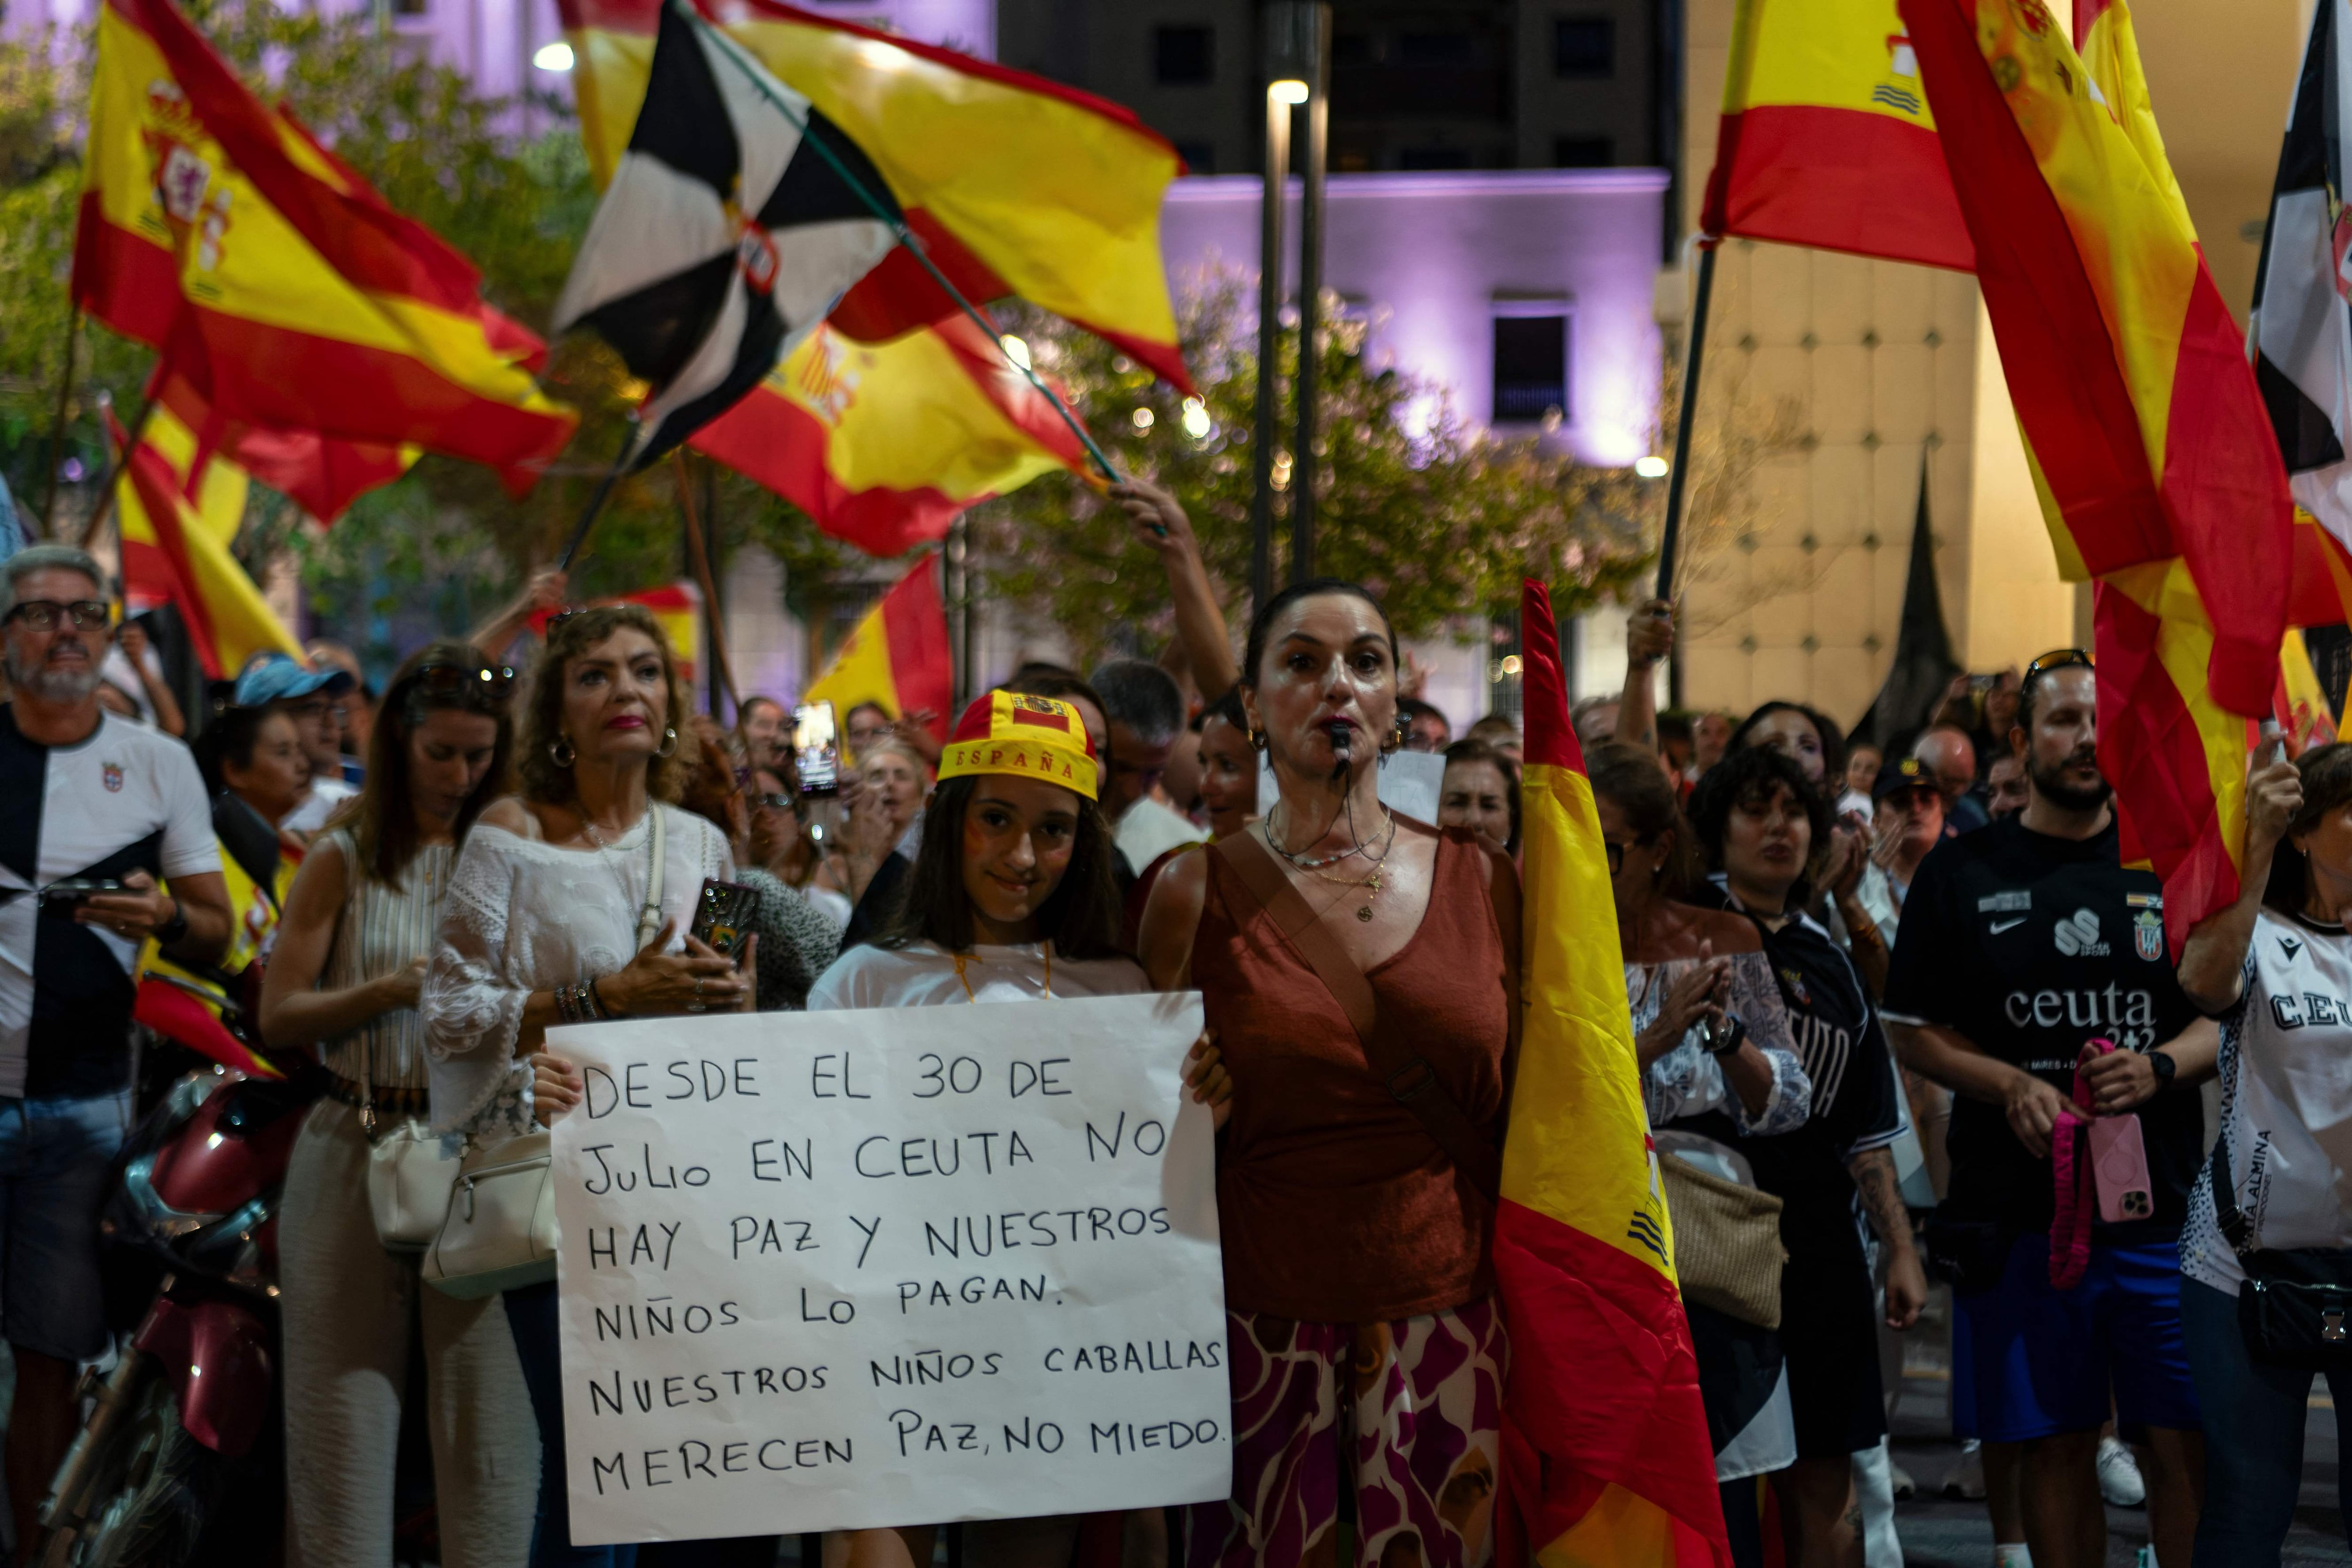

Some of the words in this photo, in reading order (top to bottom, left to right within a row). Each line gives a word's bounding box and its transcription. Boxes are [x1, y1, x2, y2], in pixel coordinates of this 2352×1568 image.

[955, 750, 1073, 780] ESPAÑA
[2004, 979, 2157, 1028] ceuta
[583, 1059, 760, 1119] DESDE
[813, 1051, 871, 1099] EL
[913, 1053, 982, 1098] 30
[1010, 1058, 1072, 1098] DE
[752, 1138, 812, 1181] EN
[856, 1130, 1033, 1178] CEUTA
[1086, 1111, 1165, 1162] NO
[2248, 1130, 2271, 1201] ALMINA
[589, 1221, 681, 1271] HAY
[731, 1216, 820, 1260] PAZ
[849, 1216, 881, 1269] Y
[925, 1207, 1170, 1258] NUESTROS
[596, 1297, 739, 1341] NIÑOS
[897, 1274, 1063, 1314] PAGAN.
[589, 1366, 828, 1416] NUESTROS
[870, 1350, 1003, 1386] NIÑOS
[1044, 1340, 1220, 1373] CABALLAS
[593, 1438, 852, 1495] MERECEN
[1004, 1417, 1064, 1453] NO
[1090, 1420, 1226, 1455] MIEDO.
